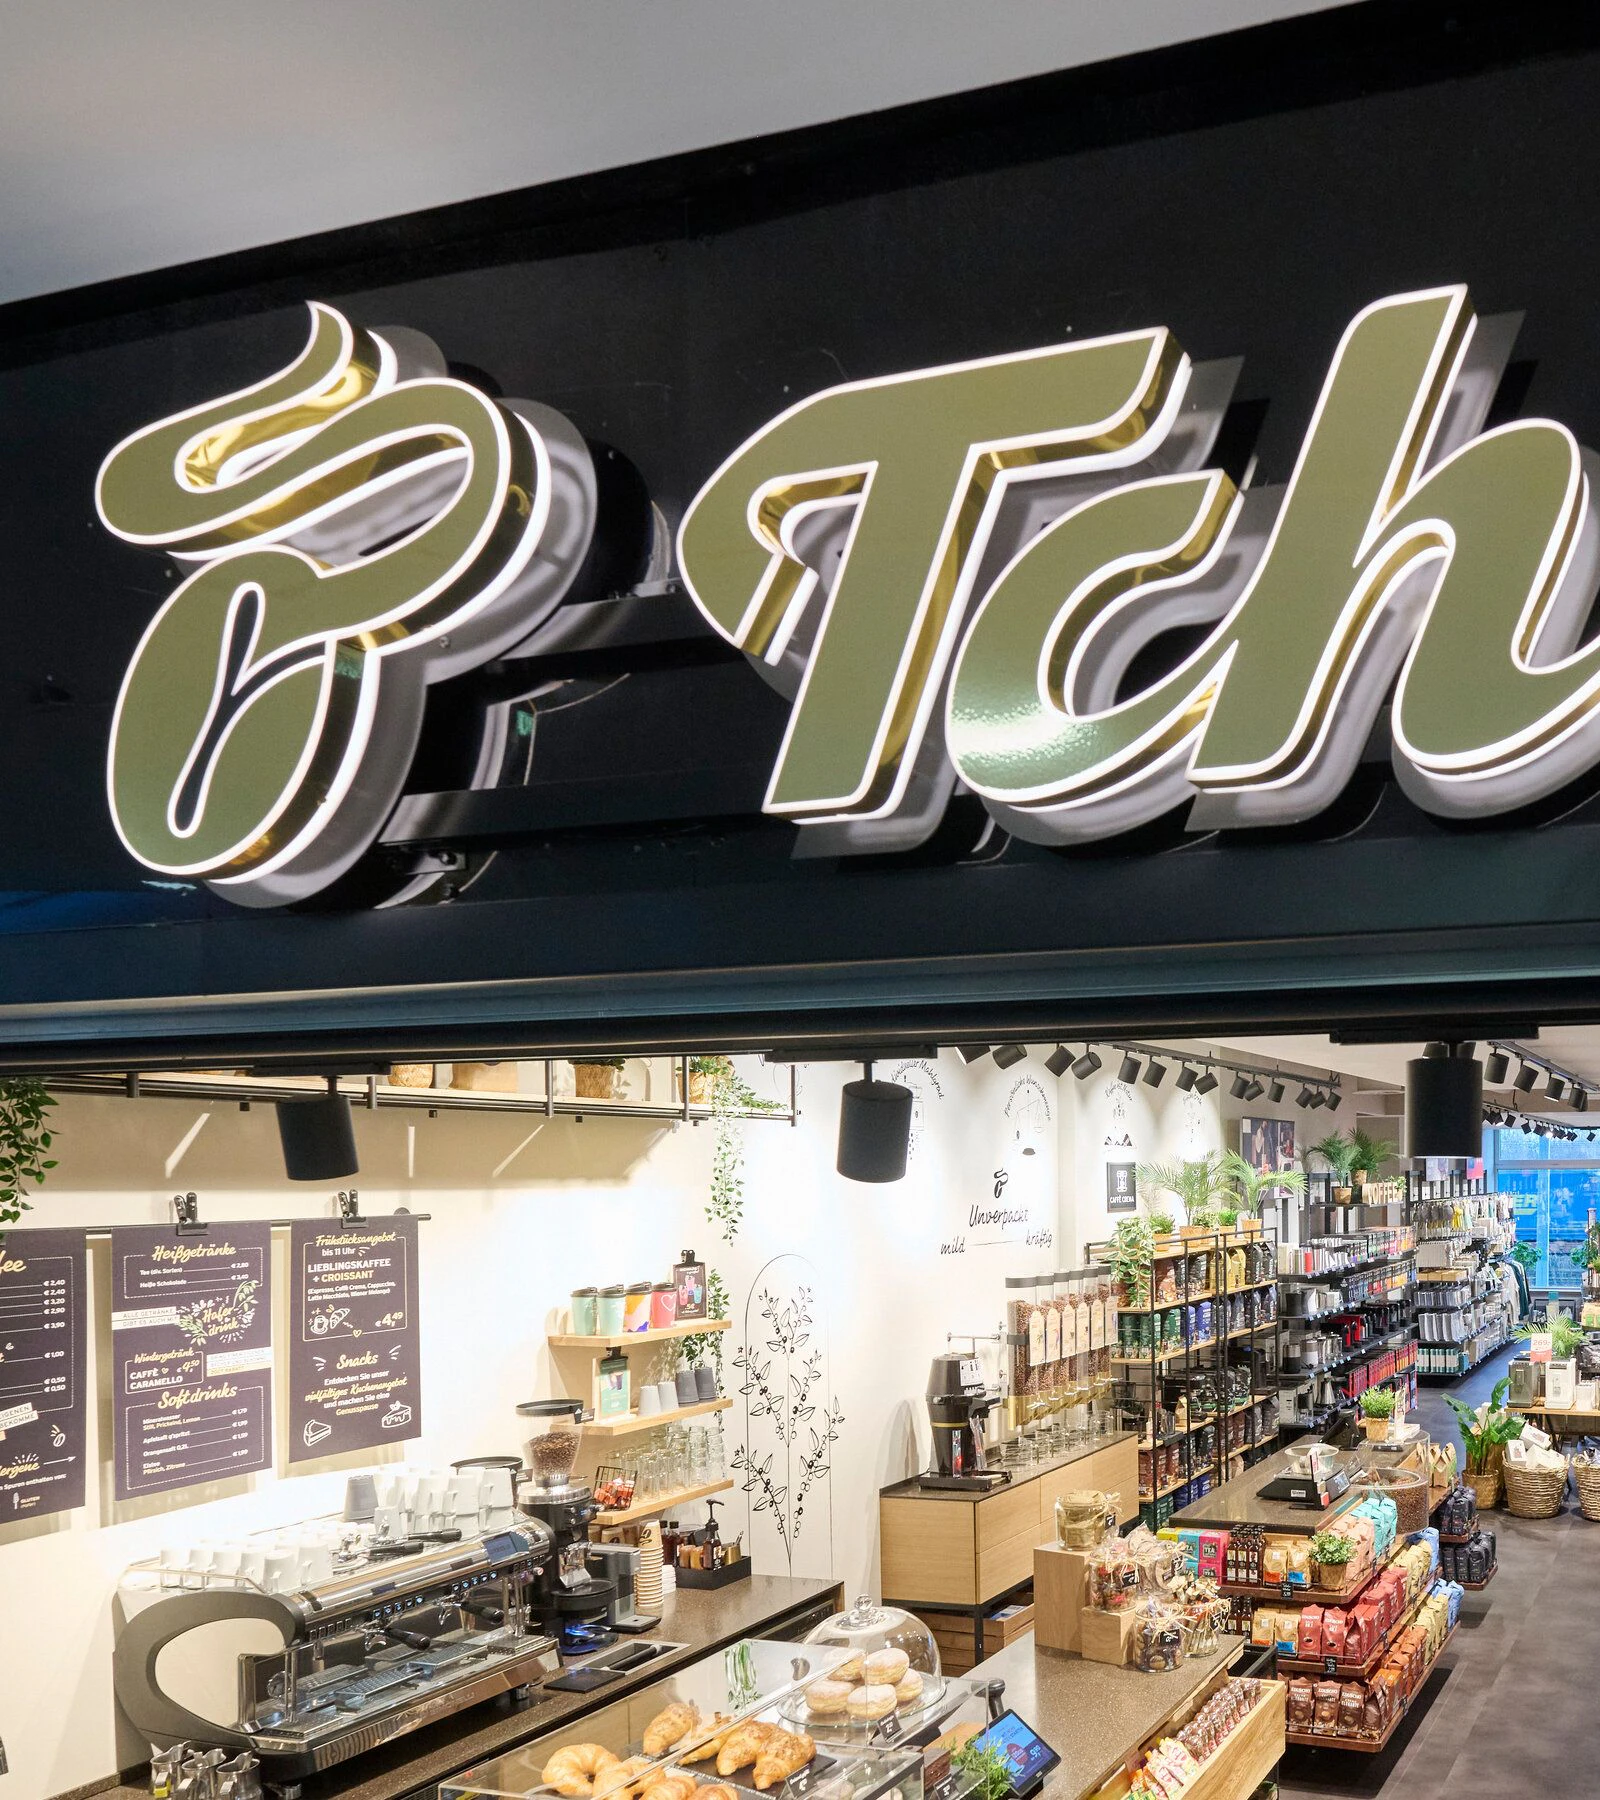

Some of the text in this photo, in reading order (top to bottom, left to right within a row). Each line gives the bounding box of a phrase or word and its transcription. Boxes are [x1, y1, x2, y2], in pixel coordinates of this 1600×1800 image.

[969, 1204, 1029, 1230] Unverpackt
[315, 1232, 397, 1247] Frühstücksangebot
[940, 1236, 966, 1255] mild
[1026, 1229, 1053, 1248] kräftig
[152, 1242, 237, 1264] Heißgetränke
[322, 1248, 334, 1256] bis
[342, 1247, 356, 1255] Uhr
[308, 1258, 391, 1273] LIEBLINGSKAFFEE
[156, 1279, 187, 1287] Schokolade
[321, 1270, 374, 1282] CROISSANT
[141, 1308, 174, 1317] GETRÄNKE
[122, 1320, 137, 1328] GIBT
[149, 1317, 166, 1325] AUCH
[208, 1319, 239, 1337] drink
[336, 1351, 379, 1369] Snacks
[130, 1376, 183, 1390] CARAMELLO
[324, 1374, 359, 1386] Entdecken
[371, 1370, 390, 1379] unser
[158, 1382, 238, 1409] Softdrinks
[305, 1376, 407, 1402] vielfältiges Kuchenangebot
[323, 1400, 337, 1409] und
[338, 1396, 364, 1406] machen
[376, 1392, 390, 1400] eine
[336, 1403, 379, 1416] Genusspause
[143, 1414, 181, 1425] Mineralwasser
[143, 1434, 168, 1444] Apfelsaft
[143, 1446, 176, 1457] Orangensaft
[4, 1481, 25, 1490] Spuren
[26, 1476, 54, 1486] enthalten
